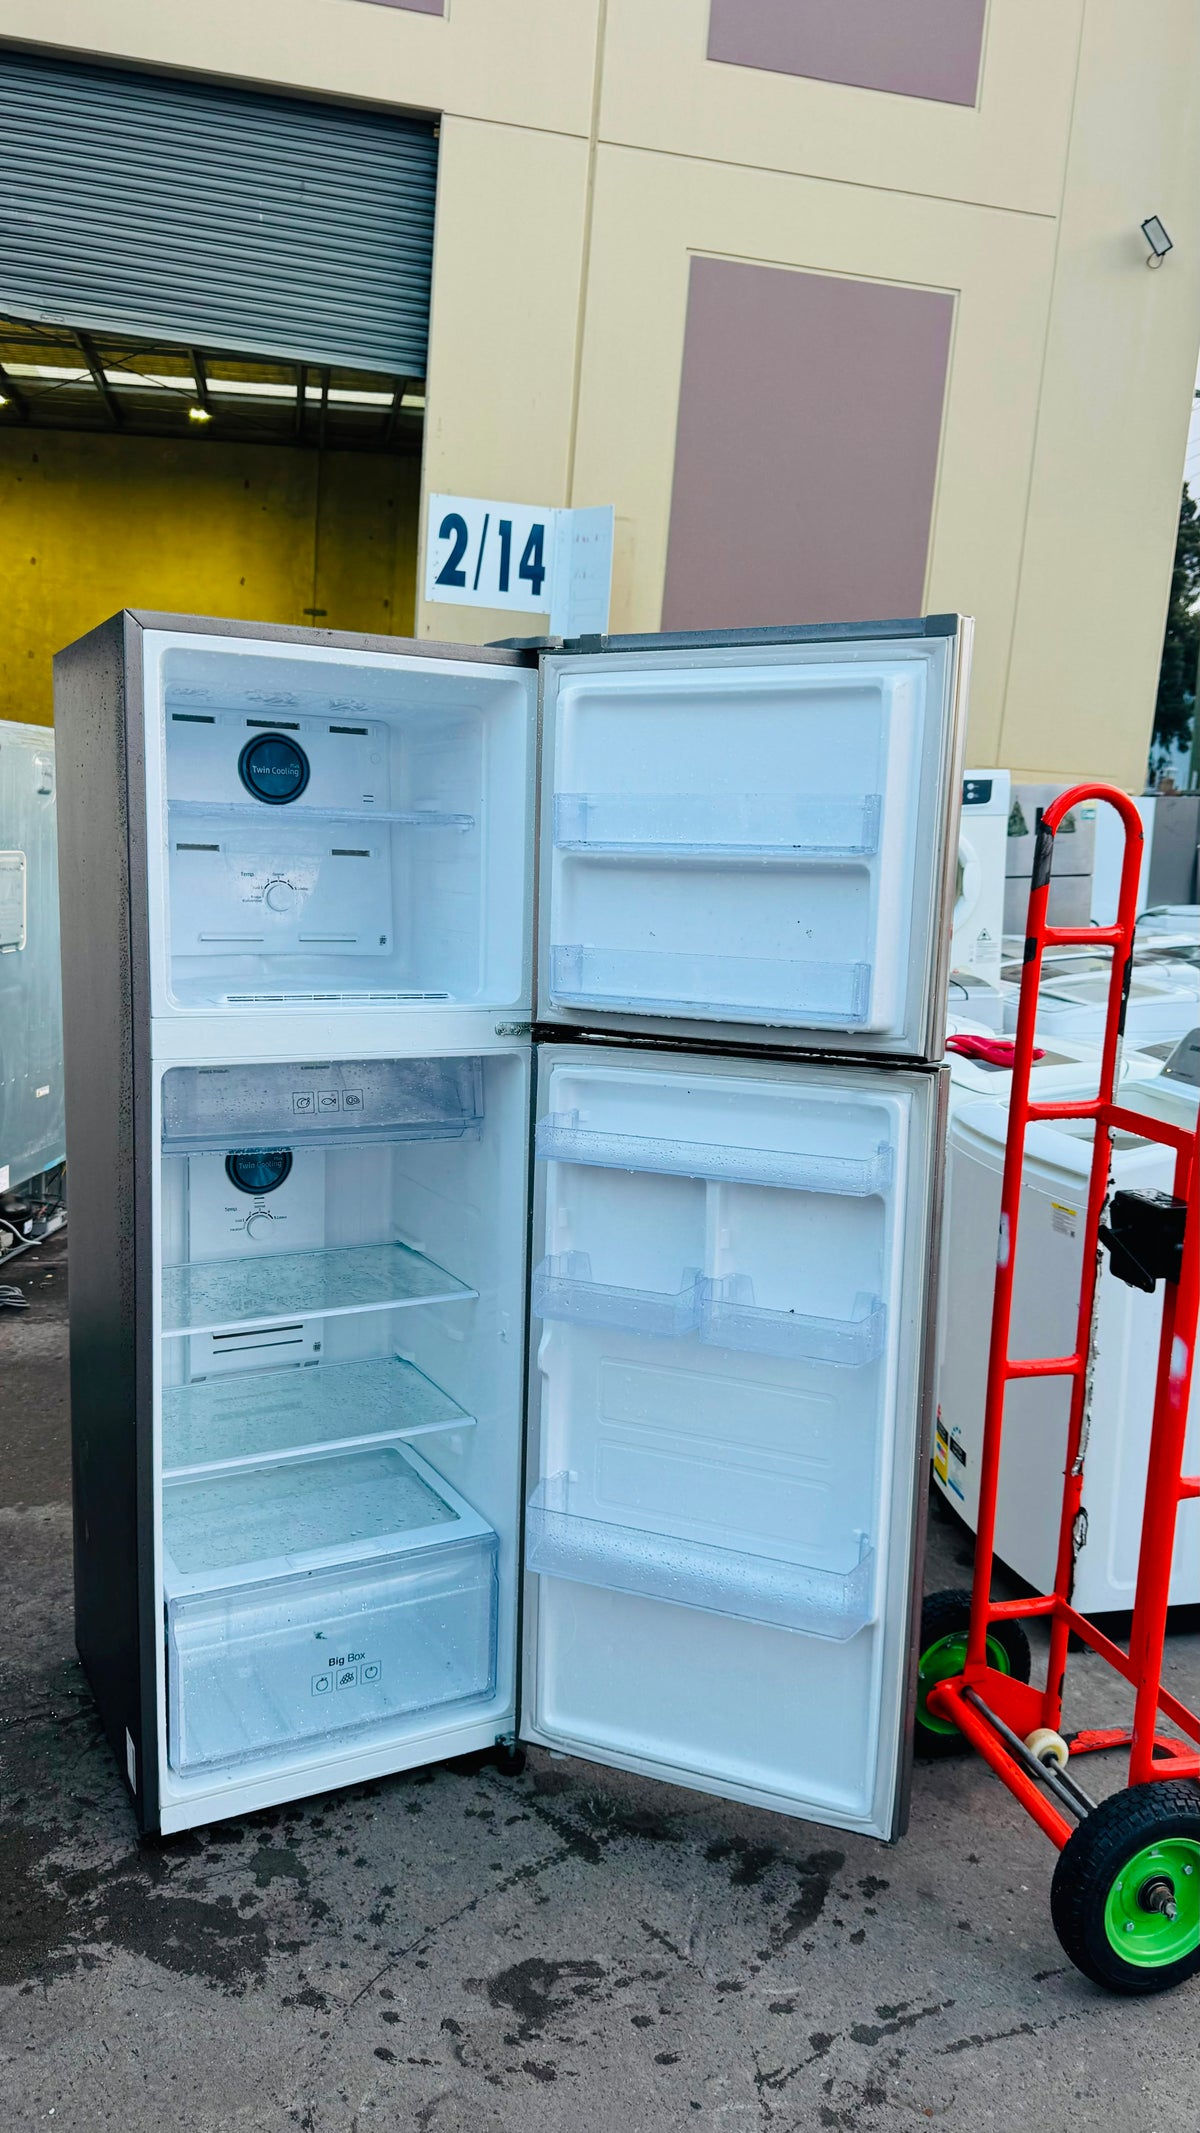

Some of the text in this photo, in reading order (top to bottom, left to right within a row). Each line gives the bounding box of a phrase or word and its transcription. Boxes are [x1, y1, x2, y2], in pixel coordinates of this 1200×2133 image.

[434, 512, 546, 596] 2/14
[252, 765, 299, 778] Twin Cooling
[238, 1160, 282, 1169] Twin Cooling
[328, 1652, 366, 1667] Big Box
